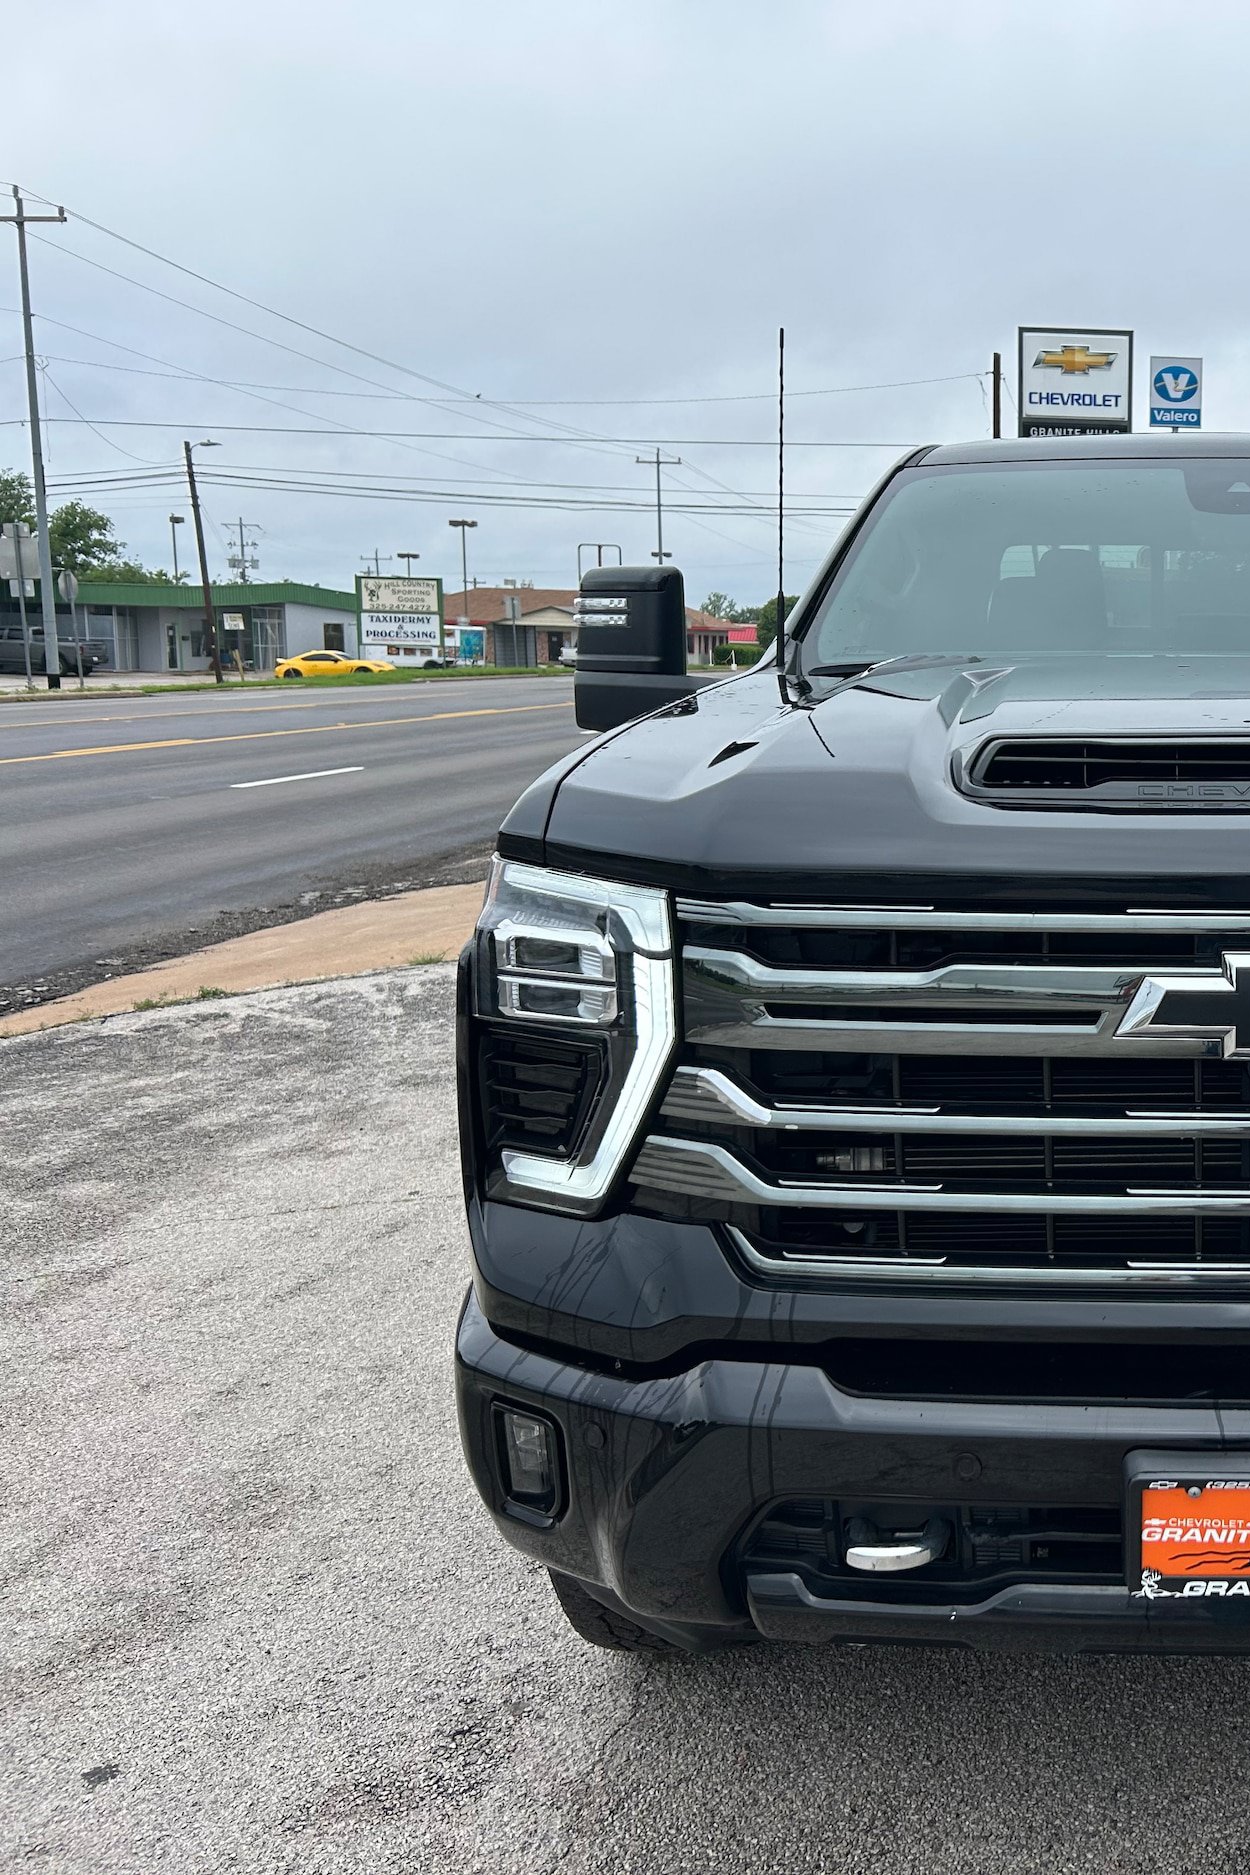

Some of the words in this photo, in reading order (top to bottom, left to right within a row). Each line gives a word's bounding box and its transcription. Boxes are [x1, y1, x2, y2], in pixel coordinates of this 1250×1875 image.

[1028, 391, 1122, 408] CHEVROLET
[1153, 409, 1198, 422] Valero
[1029, 427, 1082, 437] GRANITE
[384, 580, 400, 590] HILL
[401, 579, 436, 590] COUNTRY
[391, 588, 431, 597] SPORTING
[397, 595, 425, 603] GOODS
[368, 615, 431, 624] TAXIDERMY
[366, 630, 436, 639] PROCESSING
[1168, 1517, 1244, 1529] CHEVROLET
